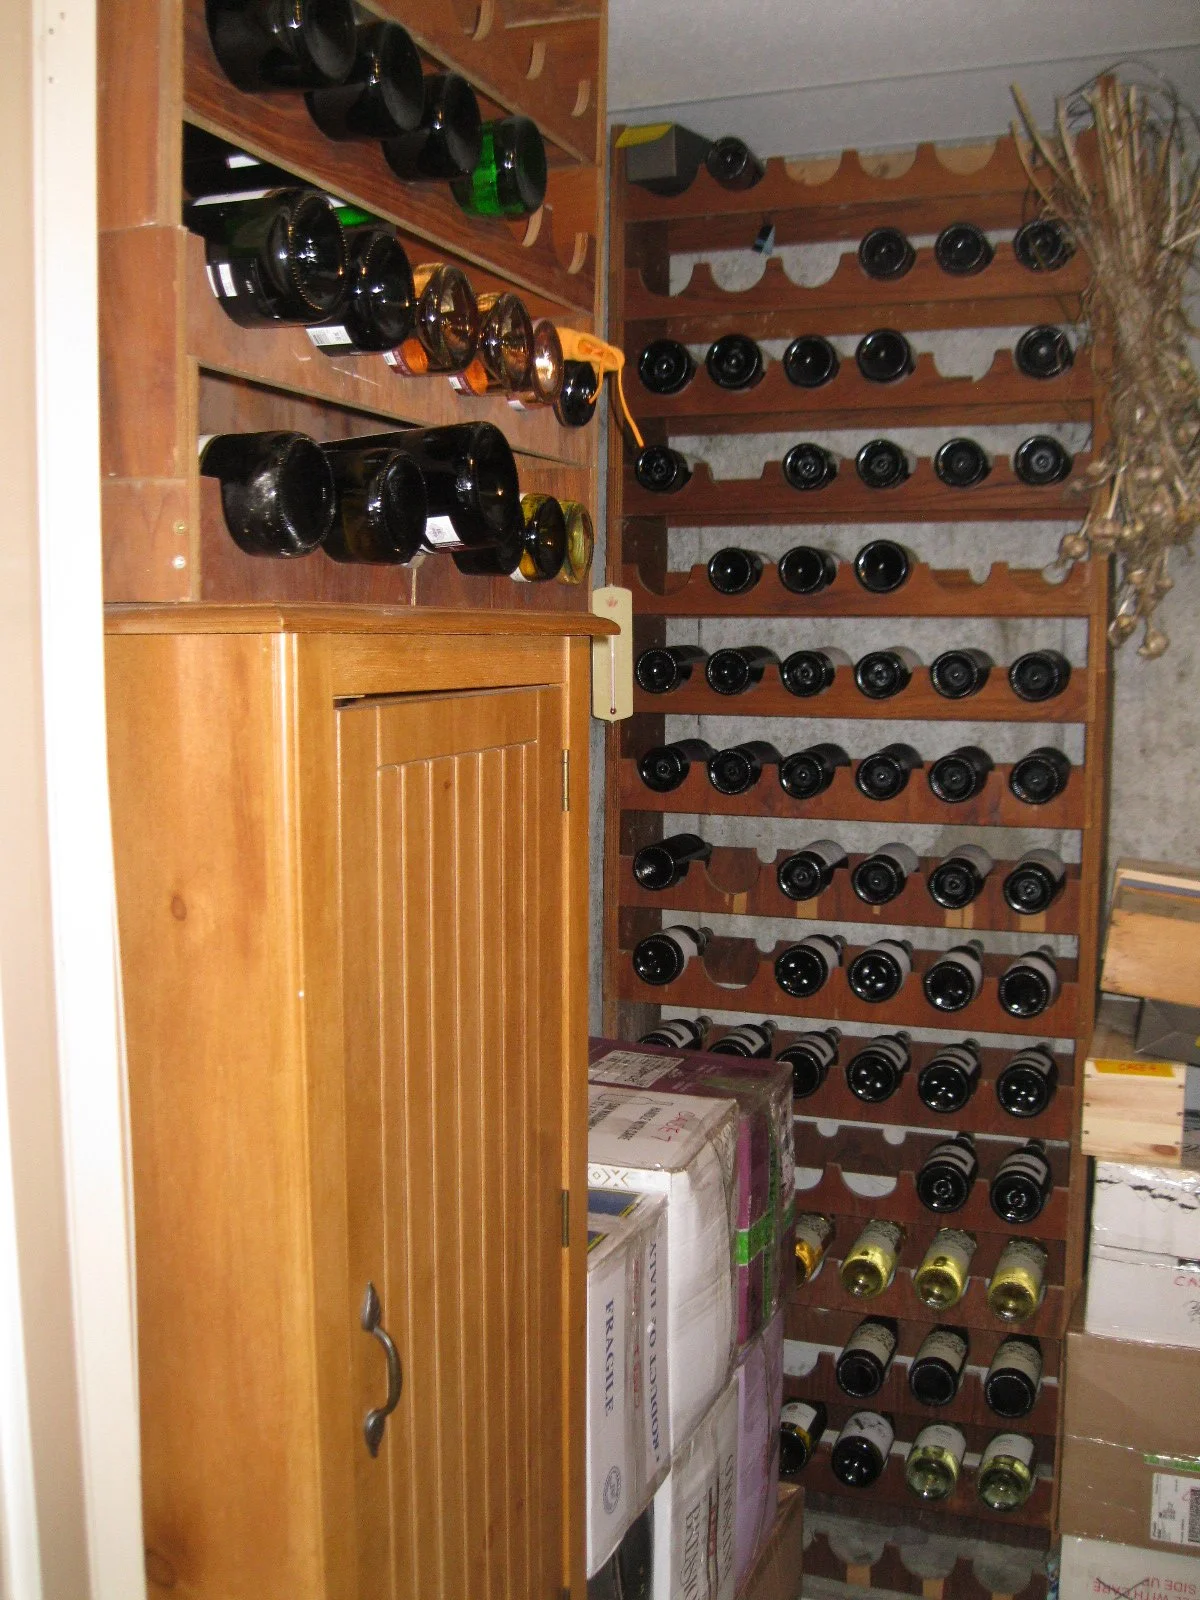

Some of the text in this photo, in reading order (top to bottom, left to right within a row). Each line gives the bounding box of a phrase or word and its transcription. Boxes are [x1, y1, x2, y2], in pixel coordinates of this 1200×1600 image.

[605, 1298, 615, 1416] FRAGILE
[649, 1353, 660, 1463] RODUCT
[1165, 1580, 1197, 1595] SIDE
